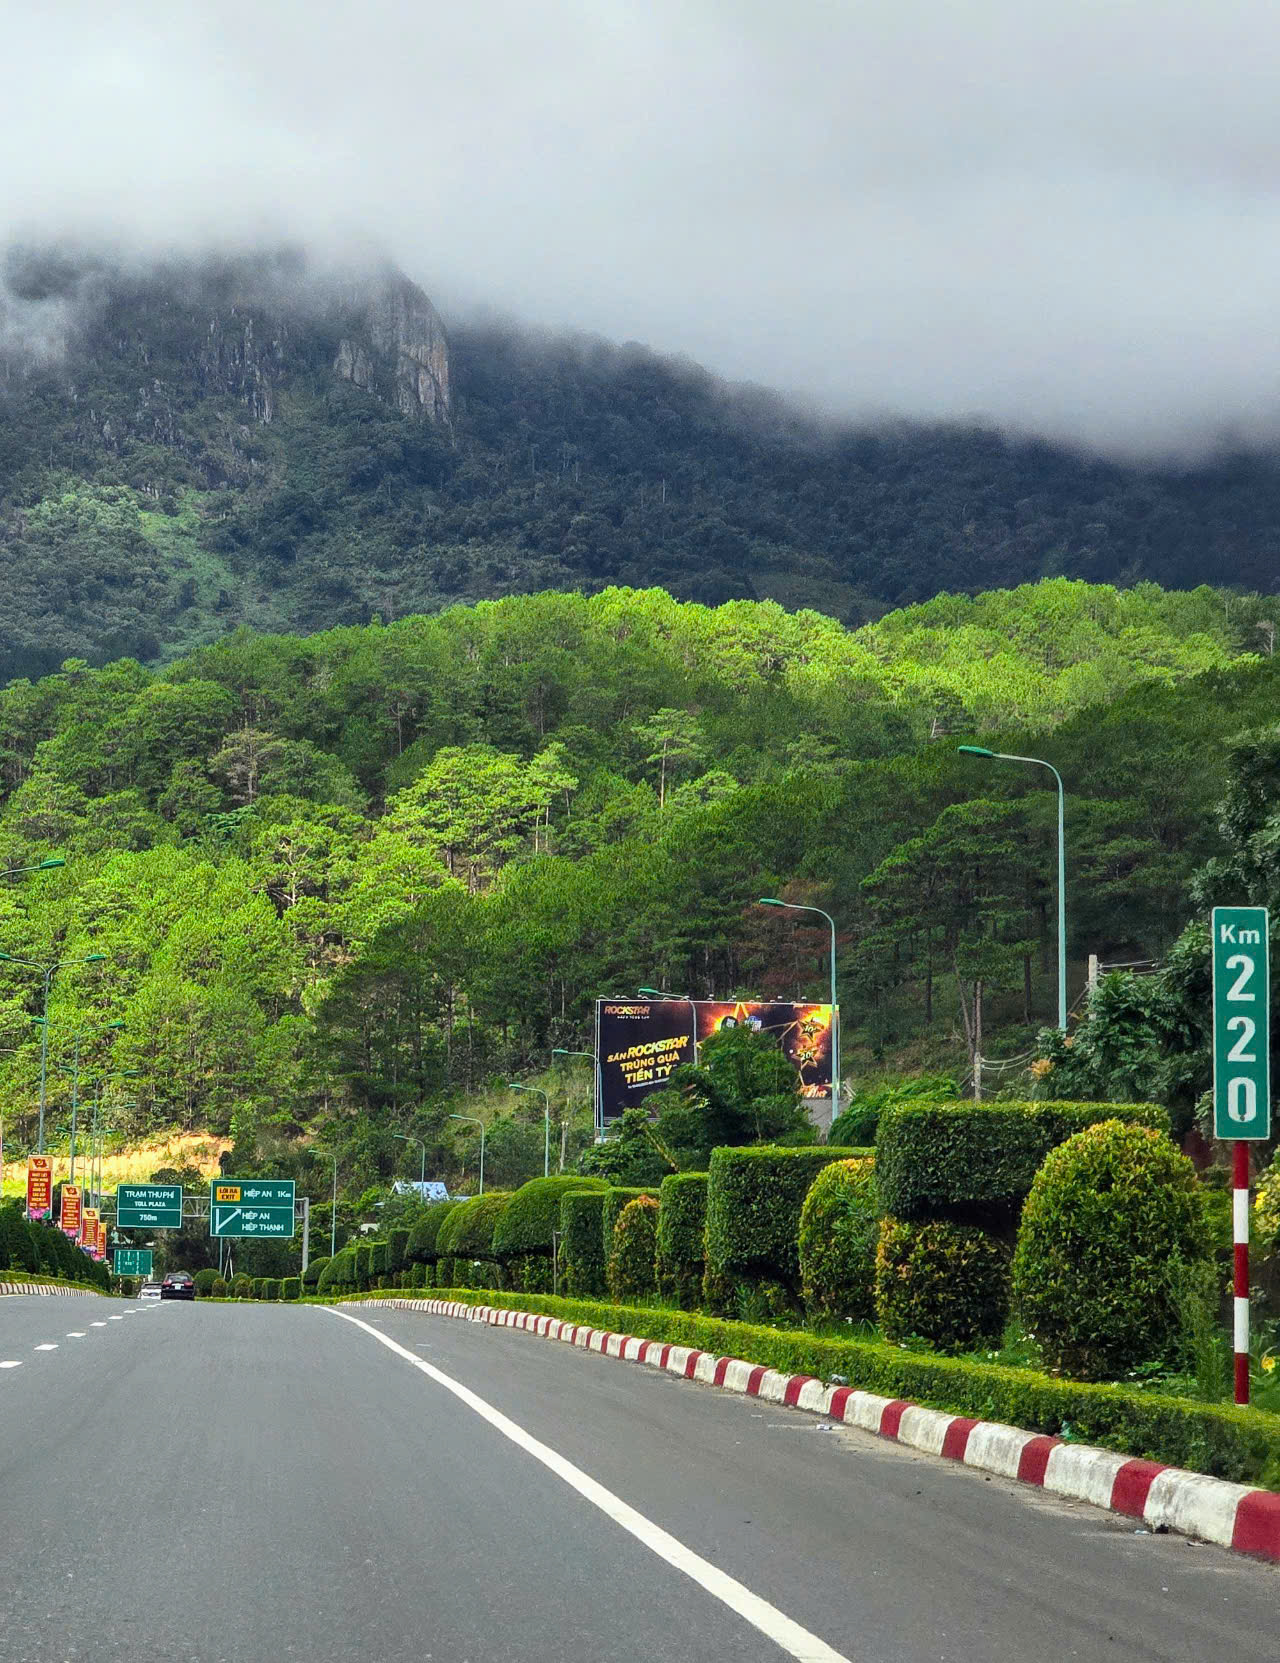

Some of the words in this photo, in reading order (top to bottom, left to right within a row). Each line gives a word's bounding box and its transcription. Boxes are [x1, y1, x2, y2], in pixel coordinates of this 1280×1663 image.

[1221, 923, 1261, 945] Km
[604, 1005, 651, 1015] ROCKSTAR
[627, 1035, 689, 1059] ROCKSTAR
[125, 1190, 147, 1199] TRẠM
[147, 1190, 163, 1199] THU
[261, 1190, 273, 1198] AN
[258, 1212, 270, 1220] AN
[258, 1224, 284, 1232] THẠNH
